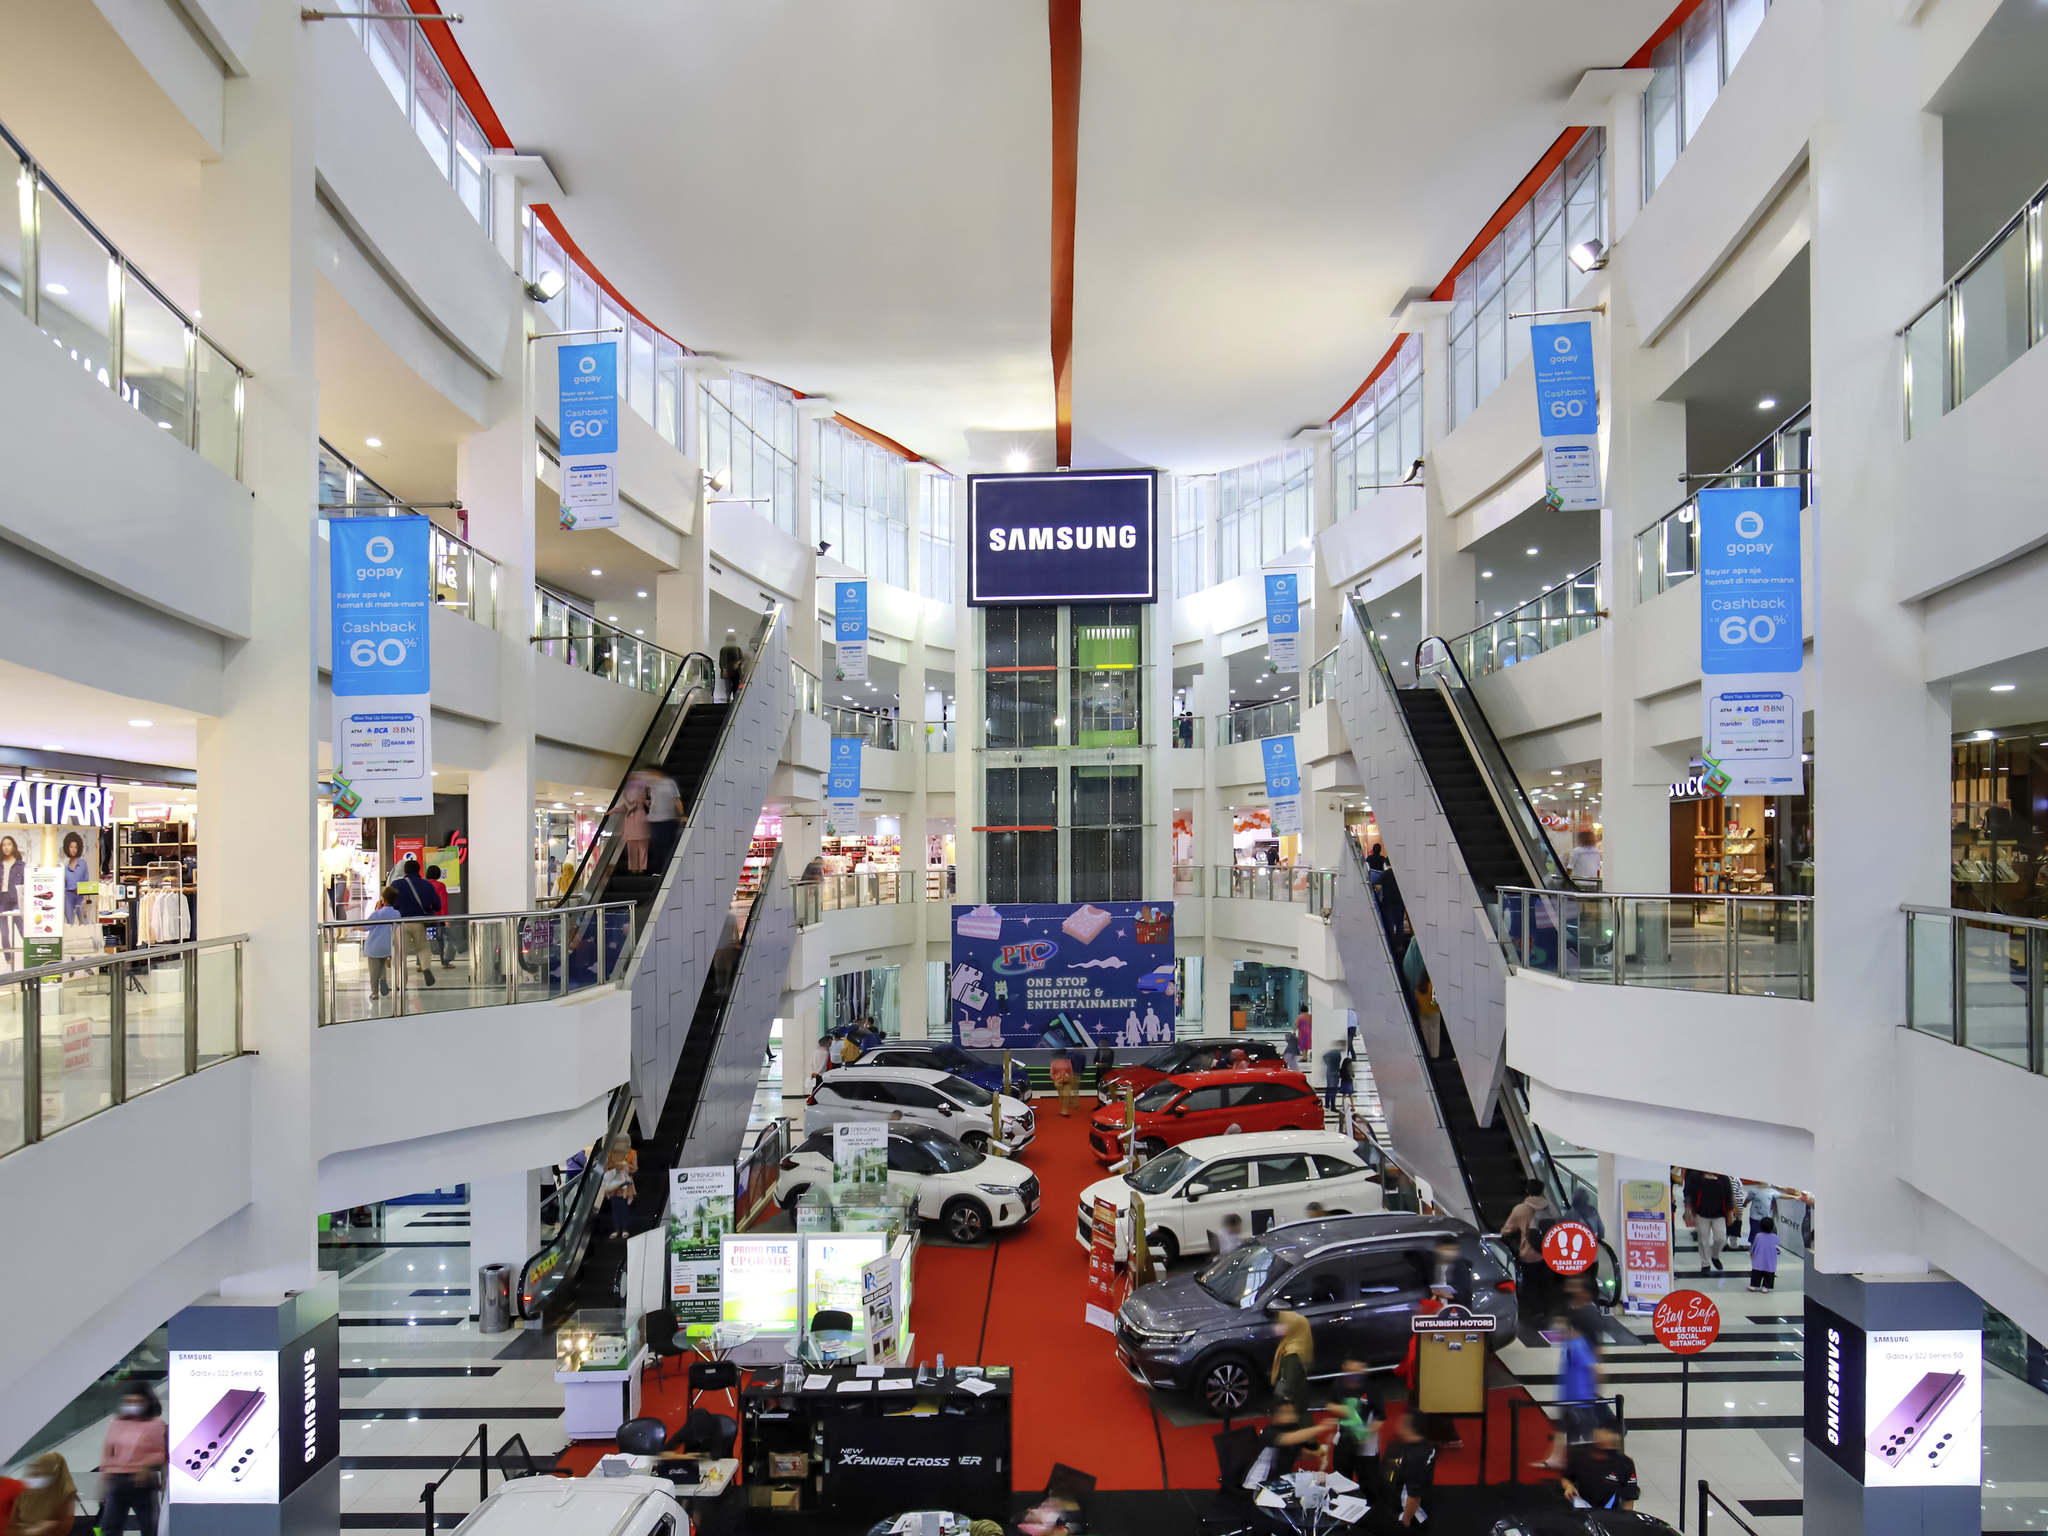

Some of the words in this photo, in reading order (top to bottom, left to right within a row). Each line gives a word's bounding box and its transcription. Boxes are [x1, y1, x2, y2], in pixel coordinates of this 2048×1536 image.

[574, 374, 601, 384] gopay
[1544, 388, 1587, 398] Cashback
[565, 407, 608, 417] Cashback
[989, 524, 1137, 552] SAMSUNG
[1726, 543, 1774, 556] gopay
[356, 567, 404, 581] gopay
[1711, 597, 1786, 610] Cashback
[342, 621, 417, 633] Cashback
[1000, 943, 1047, 966] PTC
[1026, 977, 1052, 987] ONE
[1056, 977, 1088, 987] STOP
[1026, 988, 1091, 999] SHOPPING
[1094, 989, 1103, 998] &
[1026, 999, 1137, 1010] ENTERTAINMENT
[1544, 1226, 1562, 1248] SOCIAL
[1562, 1223, 1596, 1248] DISTANCING
[766, 1245, 788, 1254] FREE
[731, 1256, 790, 1266] UPGRADE
[1629, 1250, 1656, 1268] 3.5
[1656, 1303, 1684, 1328] Stay
[1687, 1296, 1716, 1325] Safe
[1415, 1320, 1459, 1328] MITSUBISHI
[1460, 1319, 1494, 1327] MOTORS
[1873, 1336, 1909, 1344] SAMSUNG
[1827, 1328, 1840, 1446] SAMSUNG
[303, 1347, 316, 1463] SAMSUNG
[838, 1454, 906, 1466] XPANDER
[906, 1457, 951, 1467] CROSS
